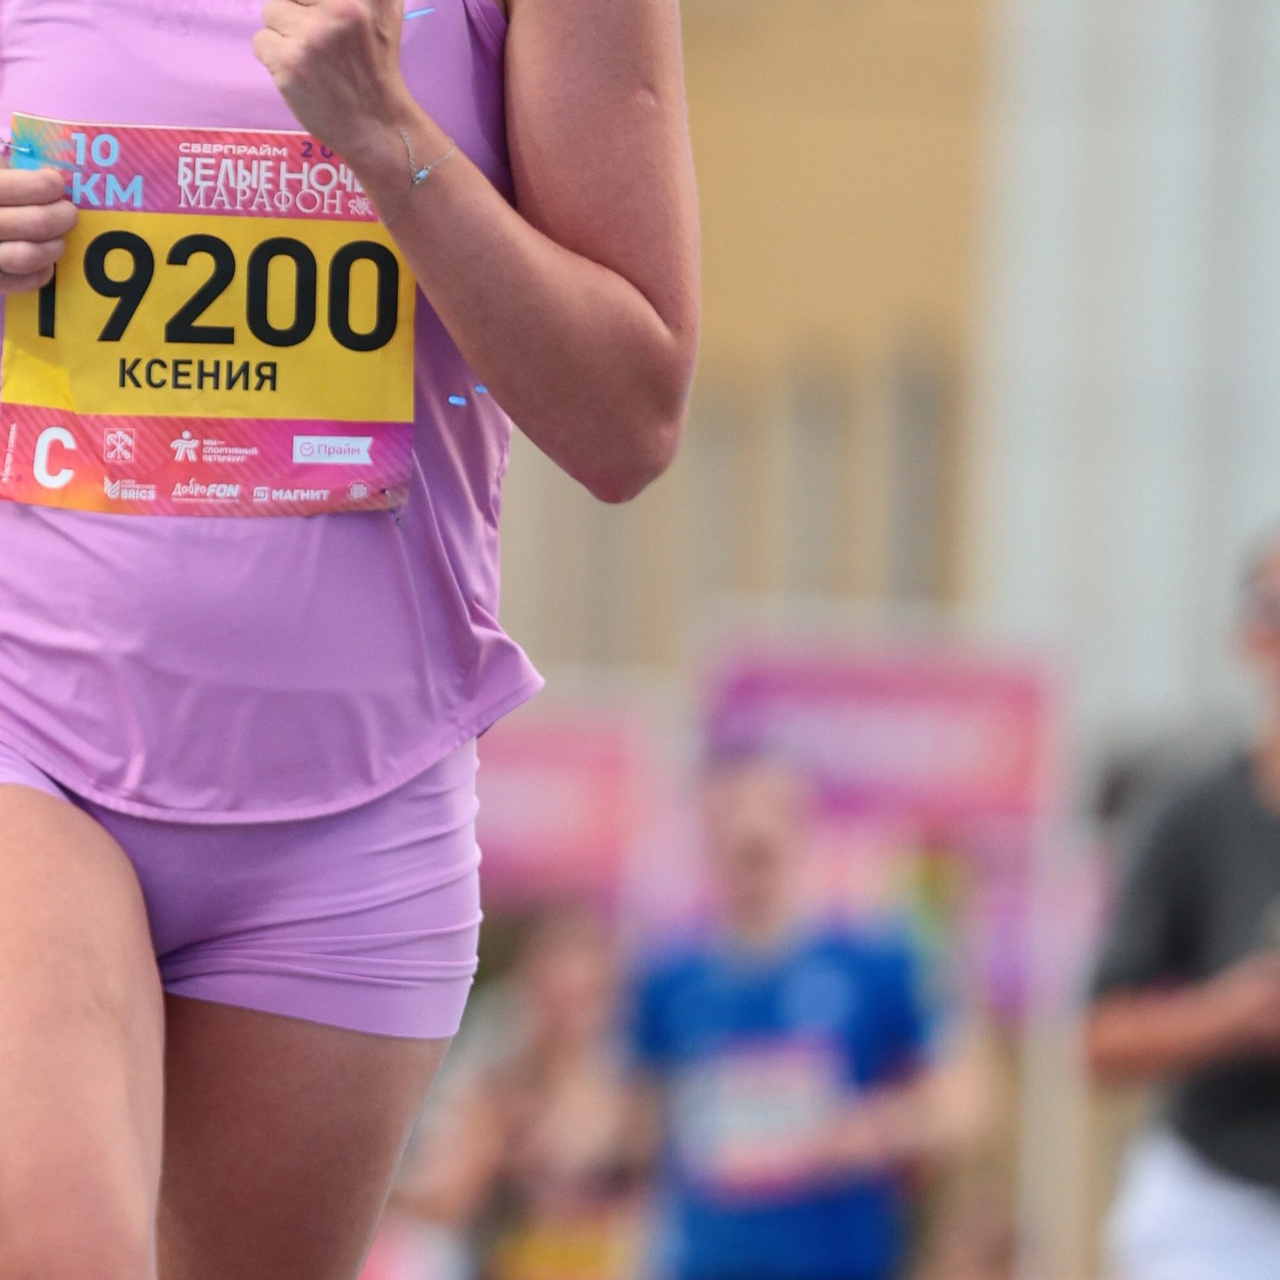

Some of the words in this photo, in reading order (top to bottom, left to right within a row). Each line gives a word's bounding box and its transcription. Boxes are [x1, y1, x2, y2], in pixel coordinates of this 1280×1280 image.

[71, 132, 119, 167] 10
[178, 142, 288, 157] СБЕРПРАЙМ
[72, 171, 144, 208] КМ
[177, 156, 274, 190] БЕЛЫЕ
[178, 184, 344, 215] МАРАФОН
[37, 229, 400, 352] 19200
[118, 357, 278, 392] КСЕНИЯ
[317, 444, 361, 456] Прайм
[272, 489, 330, 501] МАГНИТ
